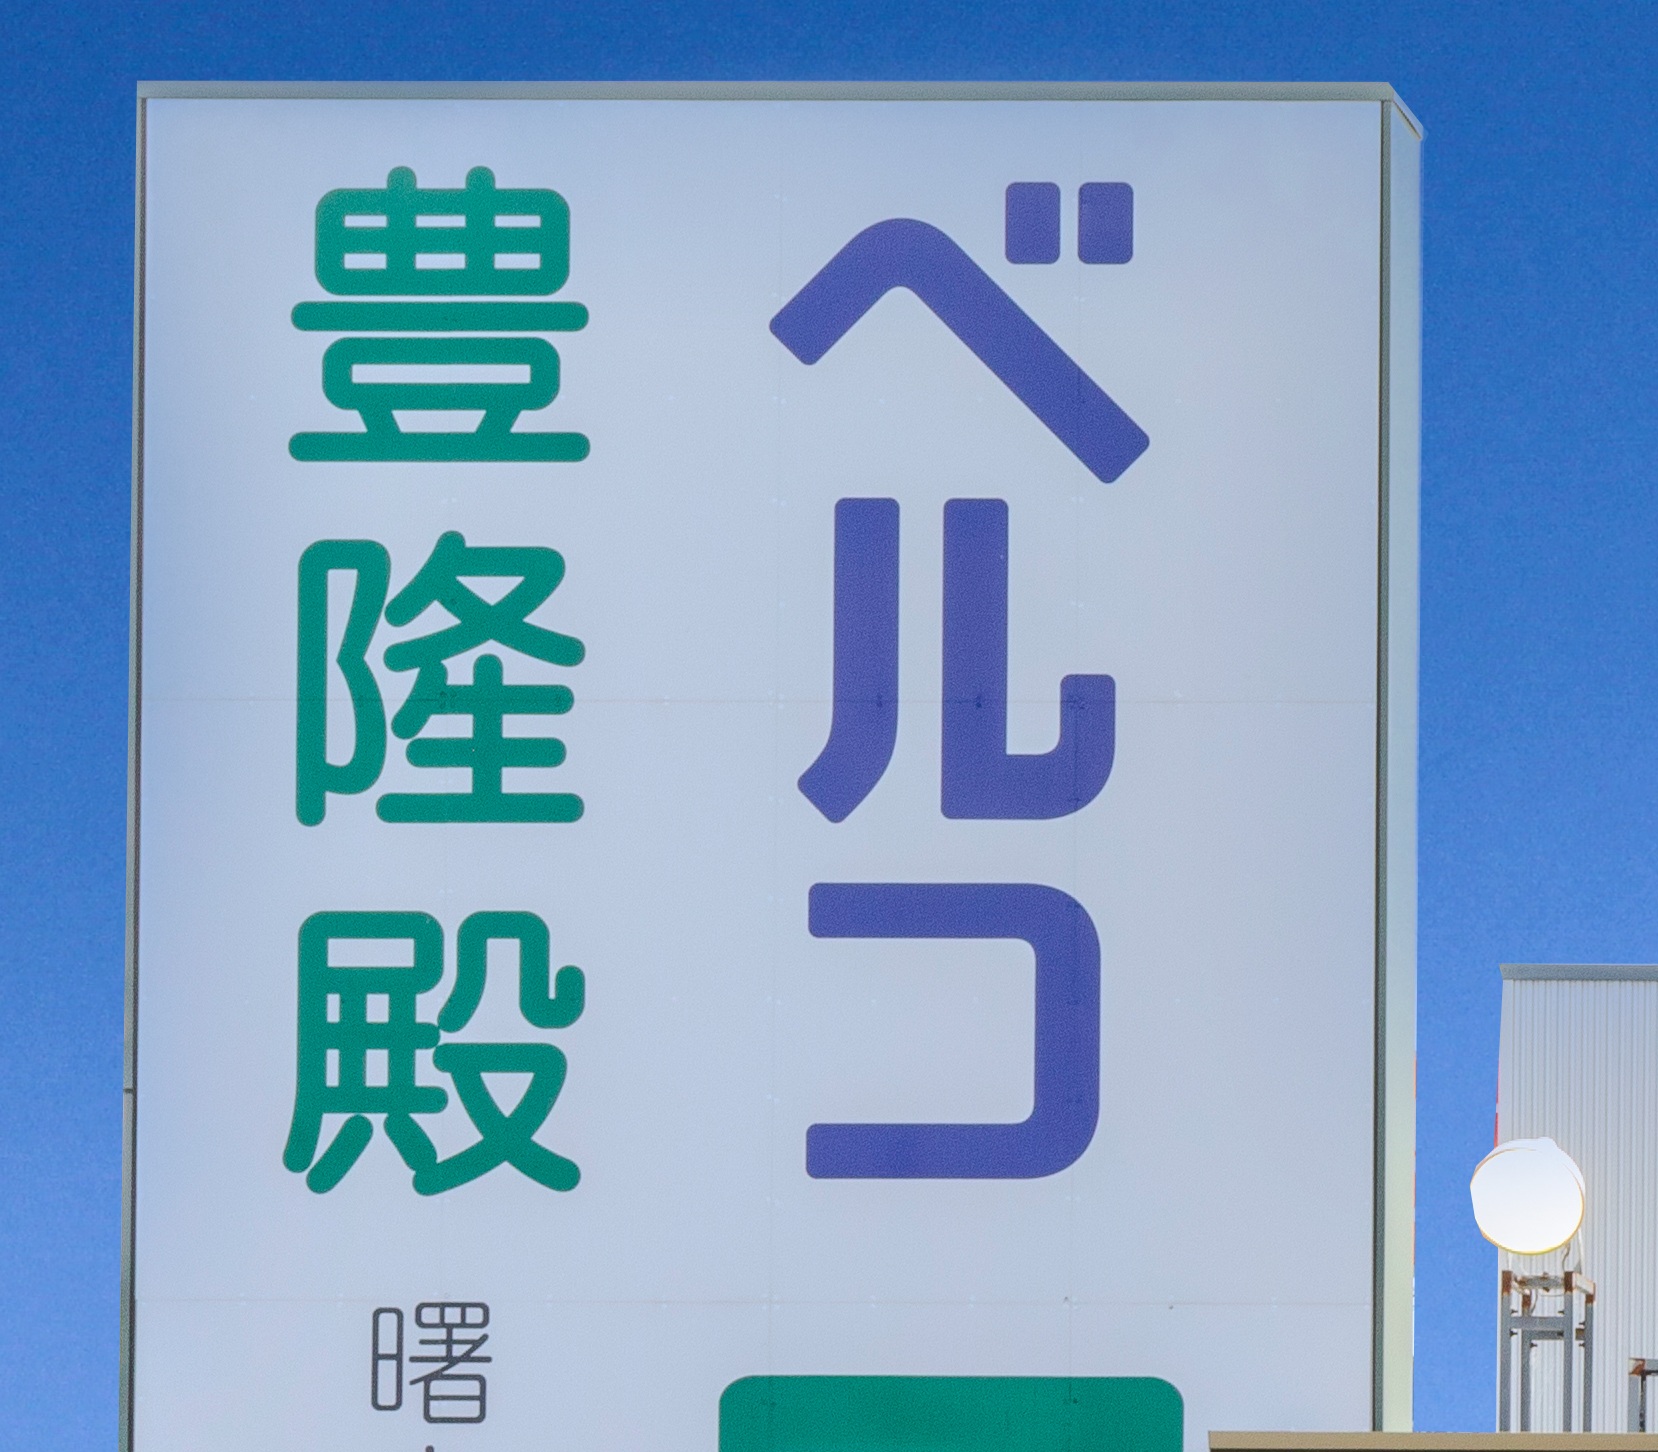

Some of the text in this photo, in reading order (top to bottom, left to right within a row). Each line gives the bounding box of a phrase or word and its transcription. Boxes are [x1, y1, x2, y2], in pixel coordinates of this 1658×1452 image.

[282, 166, 591, 1196] 豊隆殿
[769, 182, 1150, 1179] ベルコ
